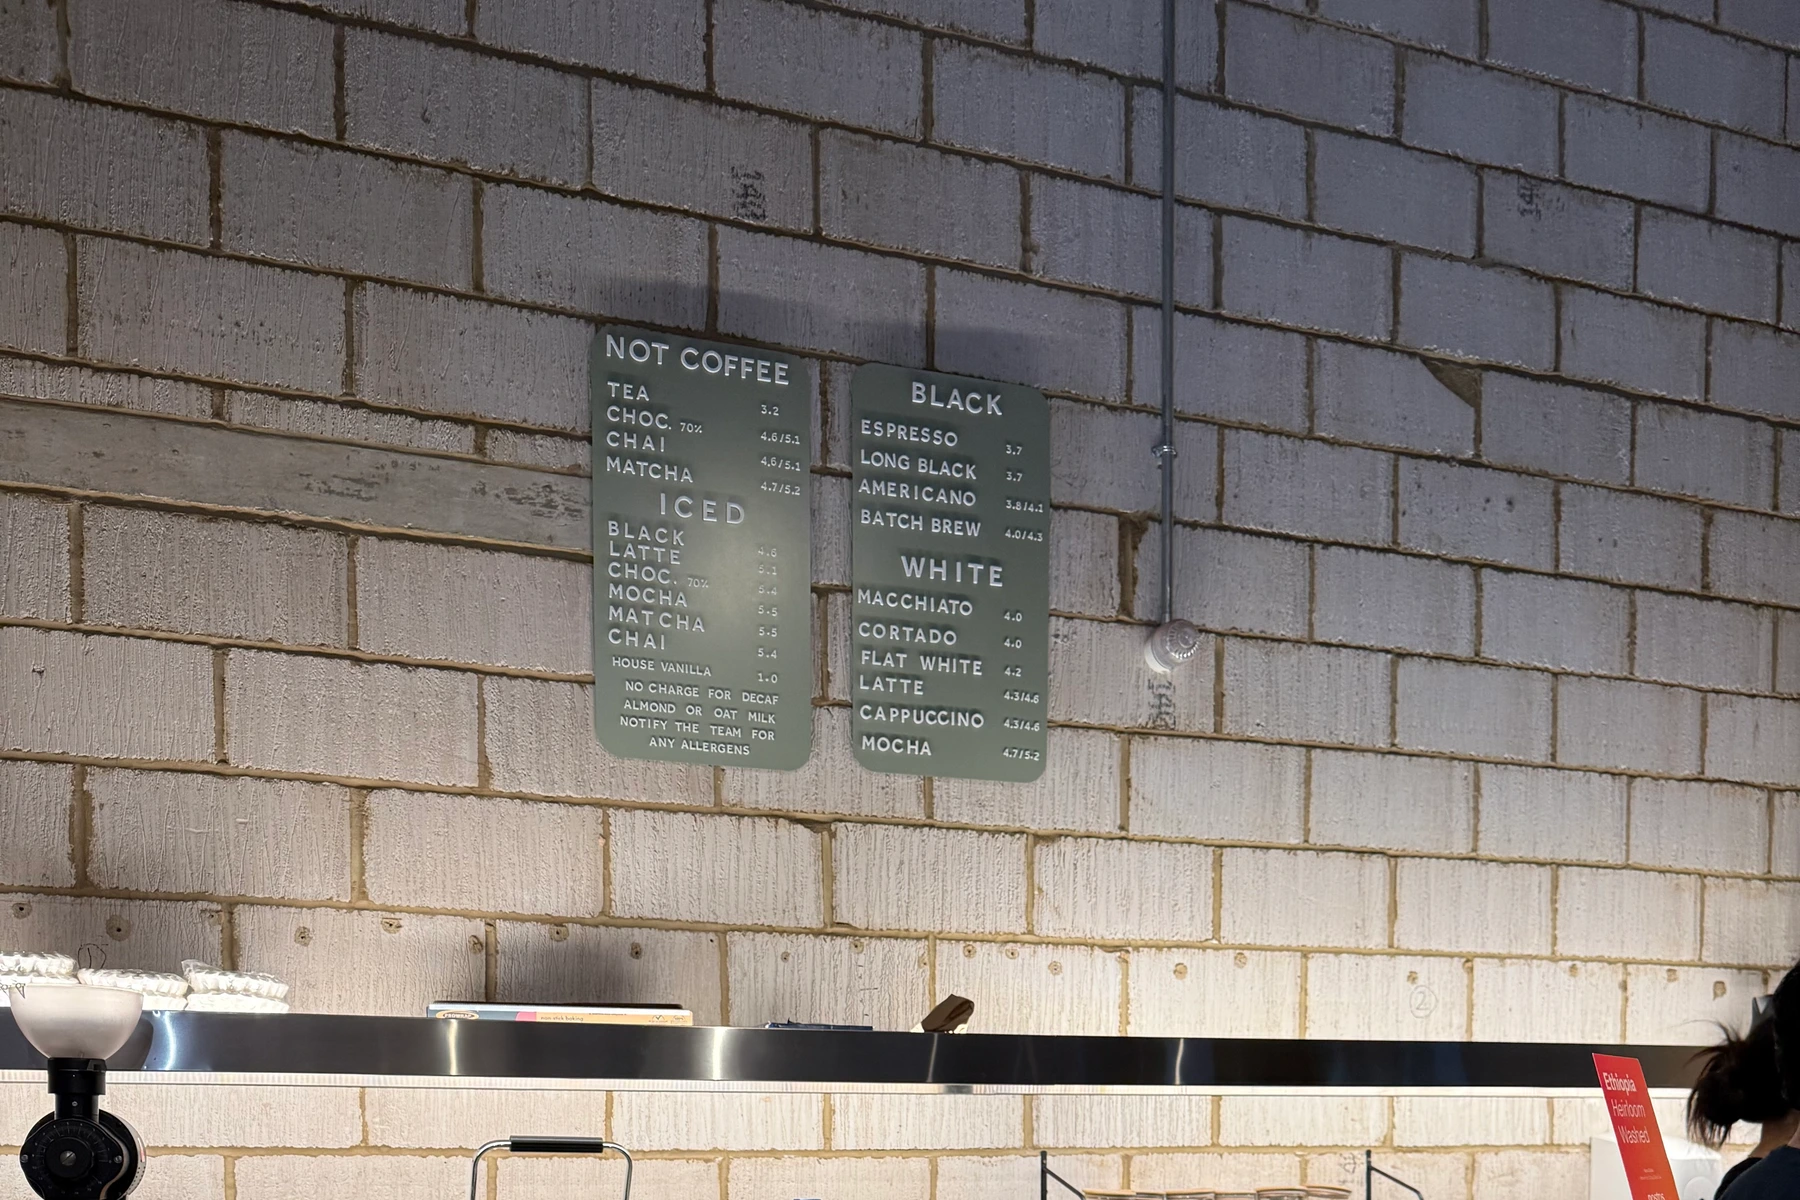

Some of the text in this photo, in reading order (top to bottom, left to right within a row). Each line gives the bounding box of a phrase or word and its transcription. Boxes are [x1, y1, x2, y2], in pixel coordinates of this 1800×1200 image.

[606, 334, 789, 385] NOT COFFEE
[607, 381, 779, 416] TEA 3.2
[912, 381, 1003, 416] BLACK
[607, 406, 800, 445] CHOC. 70% 4.6/5.1
[861, 419, 1022, 455] ESPRESSO 3.7
[606, 431, 801, 471] CHAI 4.6/5.1
[607, 456, 801, 496] MATCHA 4.7/5.2
[860, 449, 1023, 482] LONG BLACK 3.7
[660, 493, 745, 524] ICED
[858, 479, 1044, 513] AMERICANO 3.8/4.1
[608, 521, 685, 546] BLACK
[860, 509, 1043, 542] BATCH BREW 4.0/4.3
[609, 542, 681, 565] LATTE
[607, 562, 677, 585] CHOC.
[687, 578, 709, 588] 70%
[901, 556, 1003, 587] WHITE
[608, 584, 688, 607] MOCHA
[857, 588, 1022, 622] MACCHIATO 4.0
[608, 606, 777, 637] MATCHA 5.5
[858, 622, 1022, 648] CORTADO 4.0
[607, 629, 777, 659] CHAI 5.4
[612, 656, 778, 684] HOUSE VANILLA 1.0
[861, 650, 1022, 677] FLAT WHITE 4.2
[625, 681, 779, 705] NO CHARGE FOR DECAF
[860, 675, 924, 695] LATTE
[623, 699, 776, 724] ALMOND OR OAT MILK
[860, 704, 985, 728] CAPPUCCINO
[620, 716, 775, 741] NOTIFY THE TEAM FOR
[649, 738, 750, 755] ANY ALLERGENS
[861, 735, 1040, 761] MOCHA 4.7/5.2
[1603, 1072, 1637, 1097] Ethiopia
[1611, 1099, 1646, 1118] Heirloom
[1618, 1126, 1651, 1144] Washed
